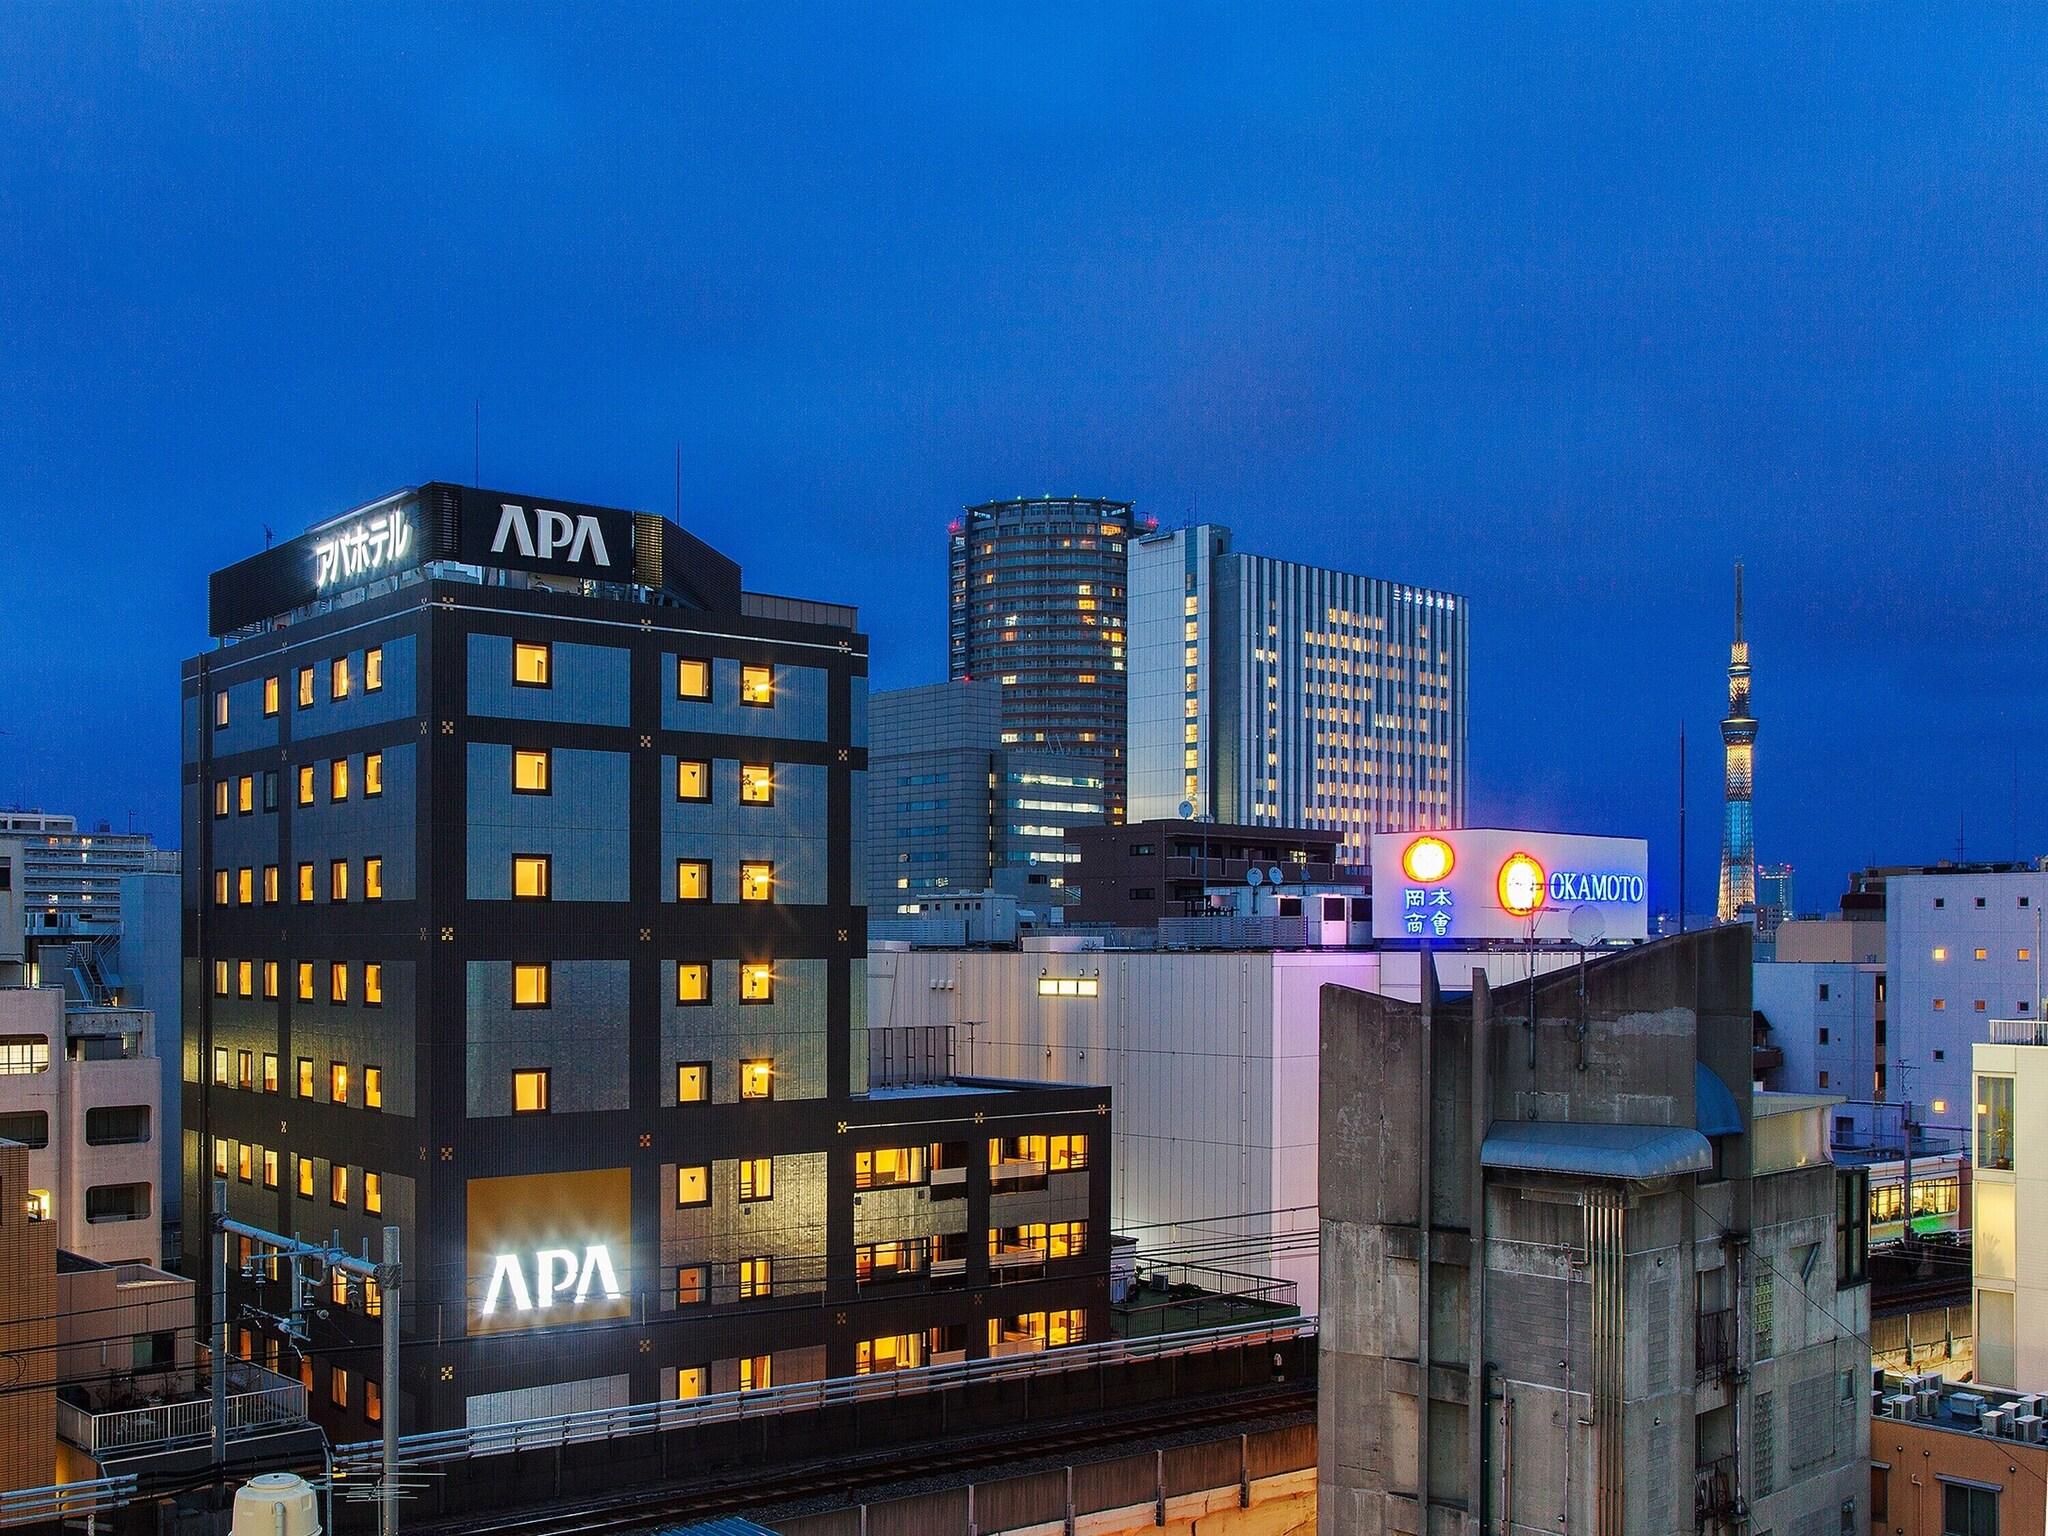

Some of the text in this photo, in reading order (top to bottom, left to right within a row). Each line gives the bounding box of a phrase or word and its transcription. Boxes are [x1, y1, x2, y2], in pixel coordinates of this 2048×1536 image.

[316, 508, 411, 588] アパホテル
[490, 503, 611, 566] APA
[1404, 888, 1453, 910] 岡本
[1550, 872, 1644, 902] OKAMOTO
[482, 1245, 621, 1315] APA
